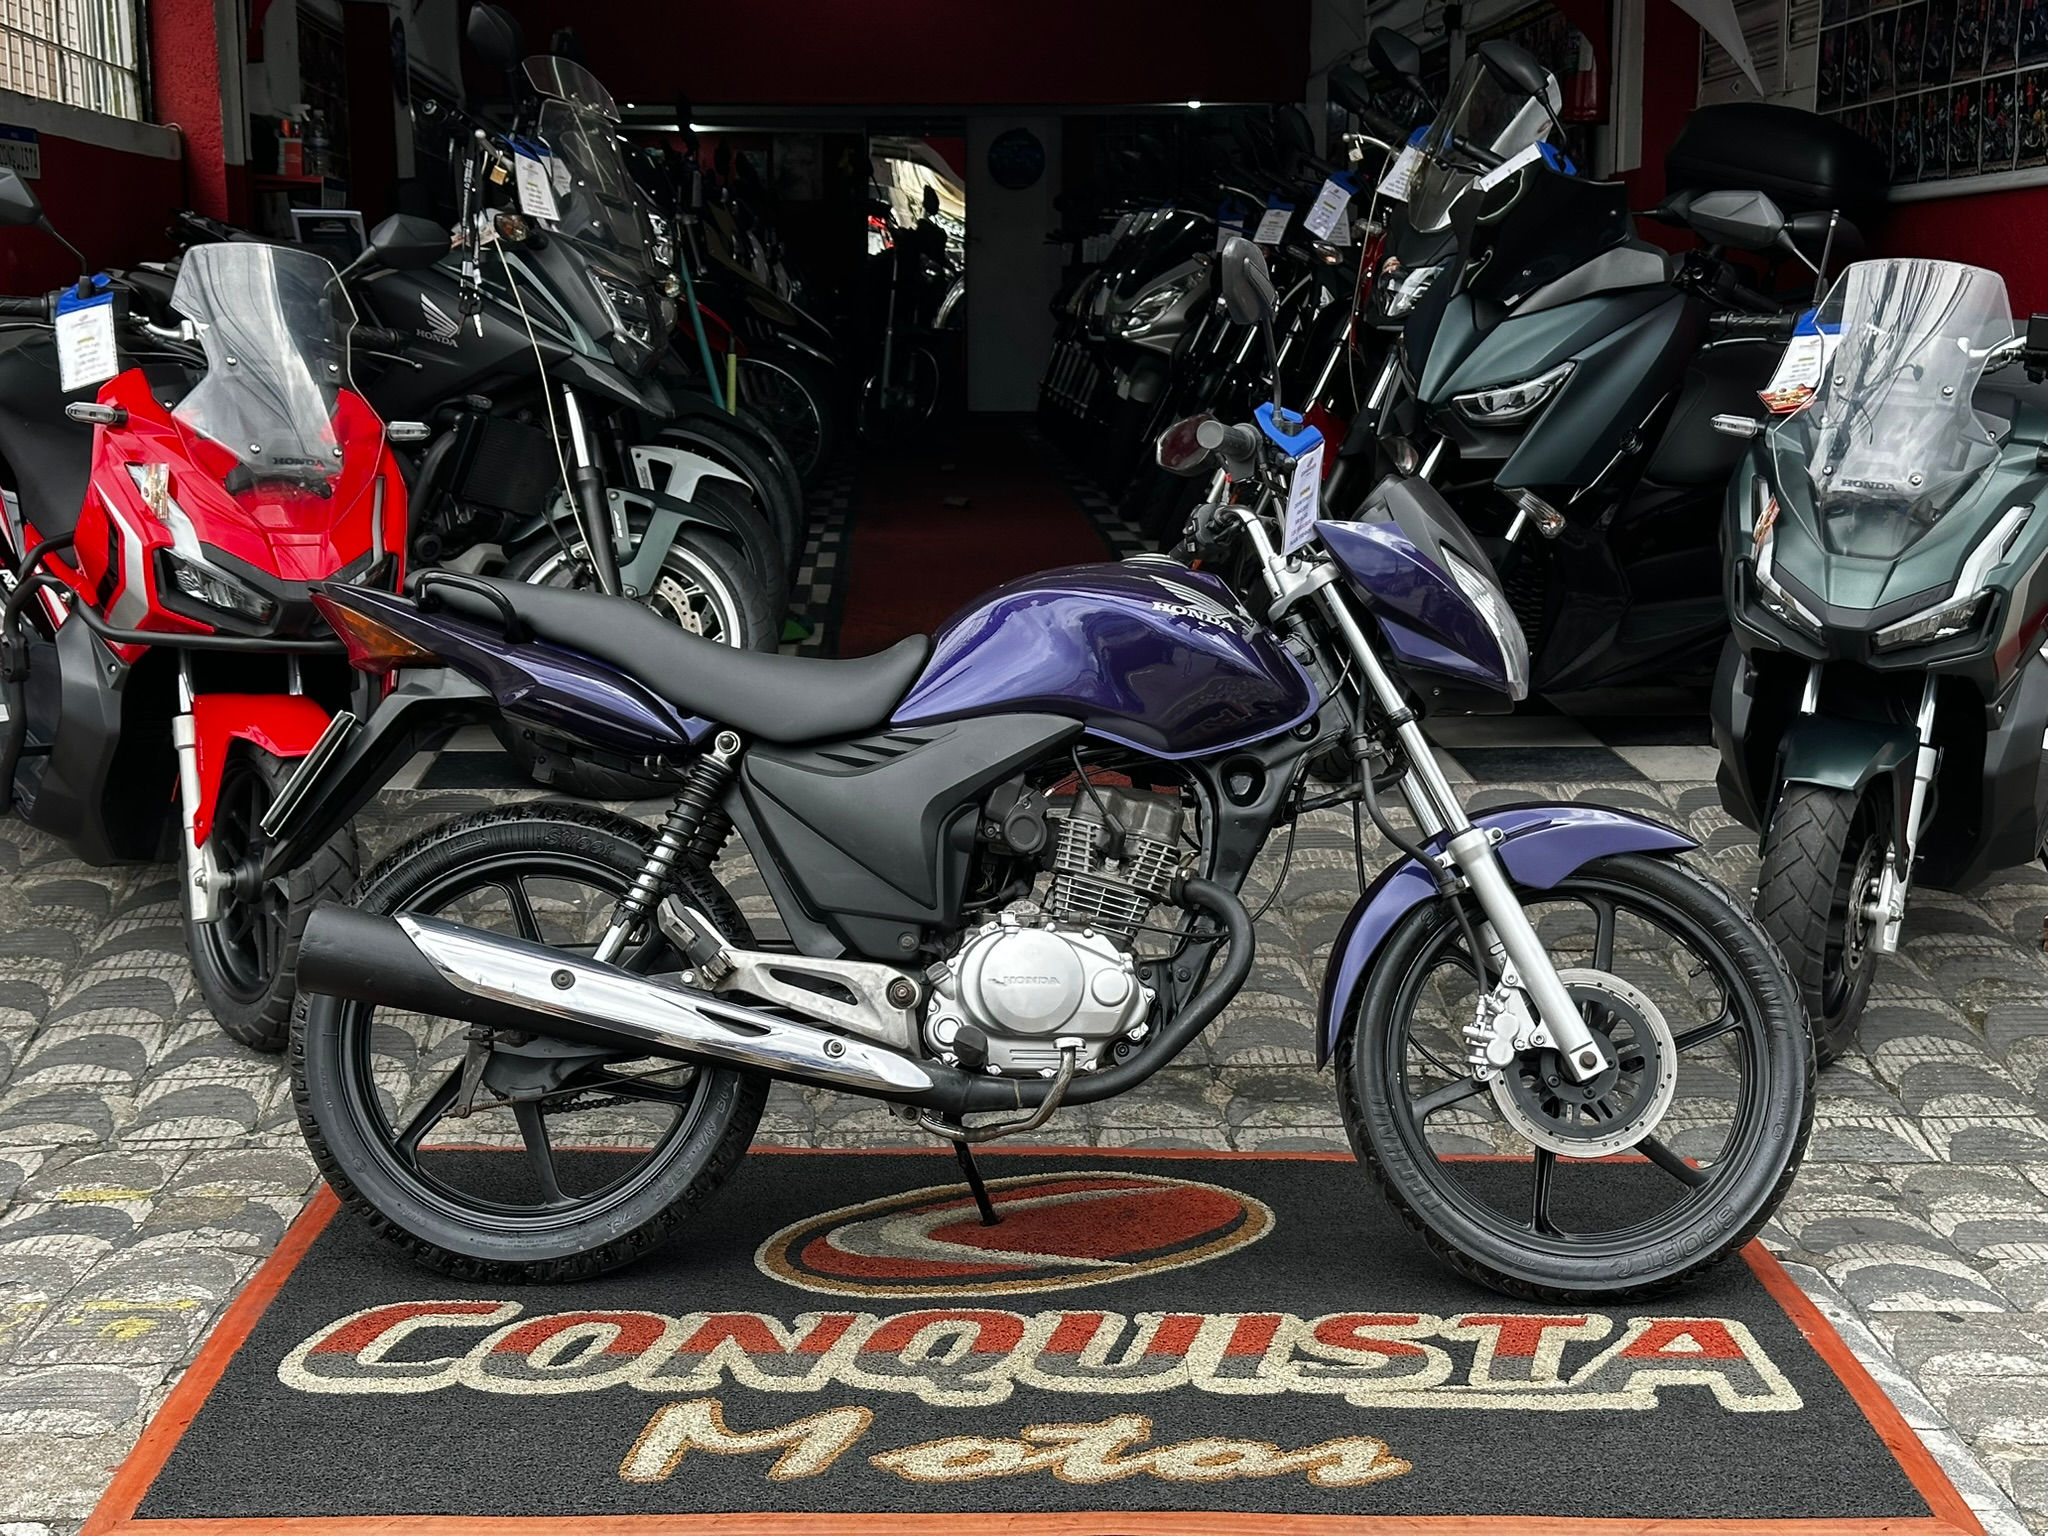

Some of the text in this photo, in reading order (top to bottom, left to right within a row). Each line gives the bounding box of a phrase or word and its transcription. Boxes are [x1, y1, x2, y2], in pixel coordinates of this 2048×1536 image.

[415, 328, 459, 348] HONDA
[272, 456, 326, 468] HONDA
[1840, 478, 1898, 492] HONDA
[1151, 601, 1238, 635] HONDA
[1002, 975, 1061, 985] HONDA
[1643, 1204, 1738, 1274] SPORT
[278, 1299, 1804, 1412] CONQUISTA
[619, 1398, 1413, 1487] Motos
